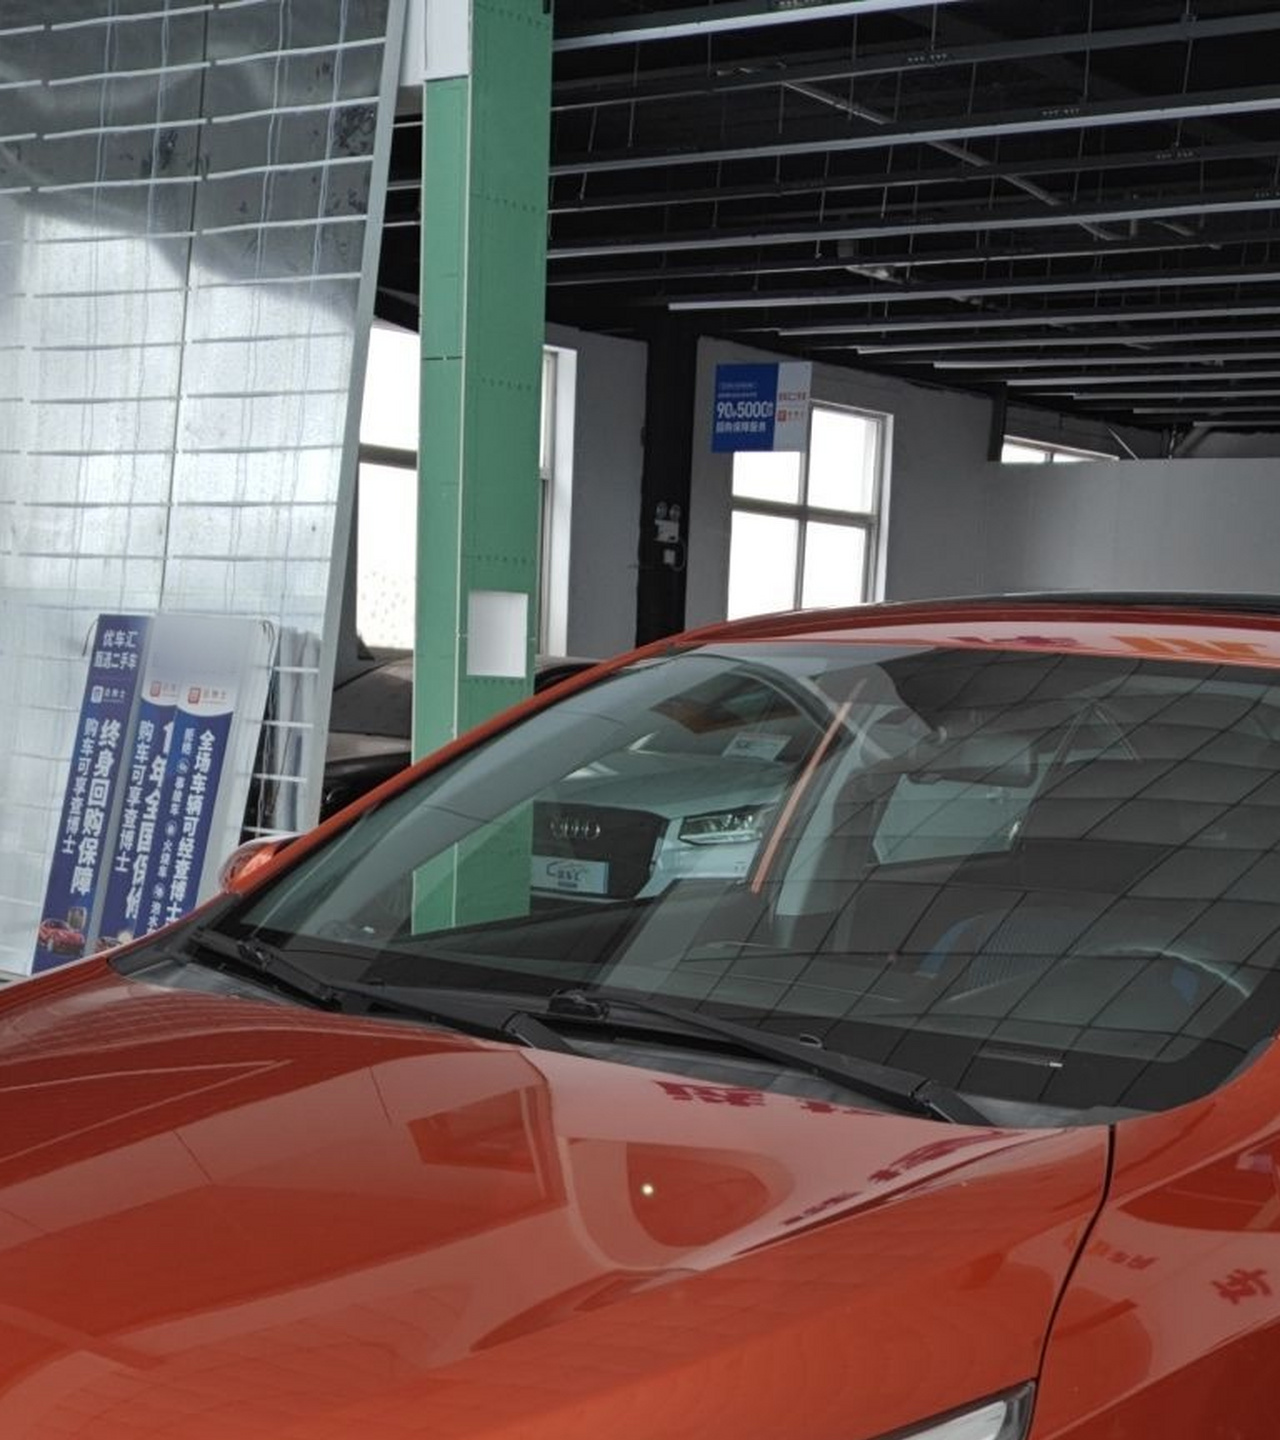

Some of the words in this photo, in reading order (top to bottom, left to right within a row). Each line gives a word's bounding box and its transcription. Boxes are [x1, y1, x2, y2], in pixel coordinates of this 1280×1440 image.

[103, 629, 139, 648] 优车汇
[62, 717, 99, 854] 购车可享查博士
[70, 719, 120, 895] 终身回购保障
[115, 719, 154, 873] 购车可享查博士
